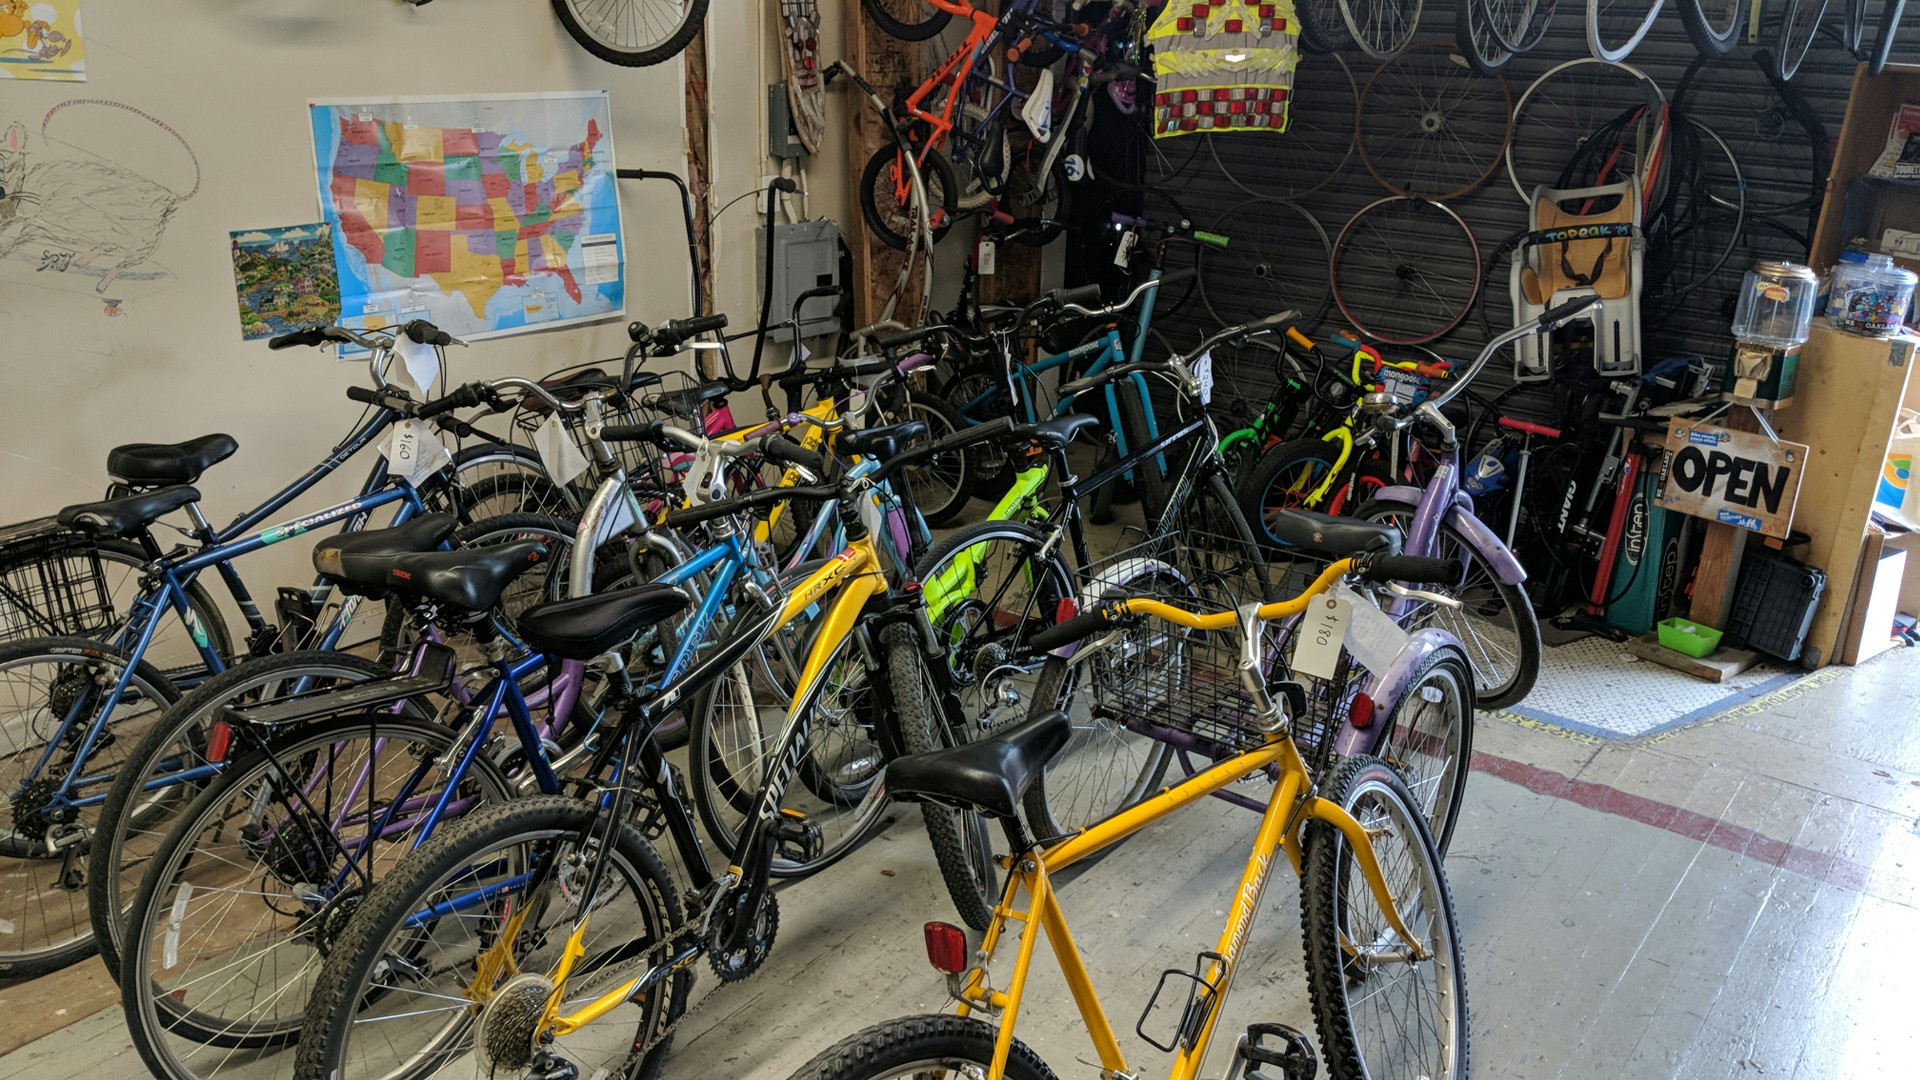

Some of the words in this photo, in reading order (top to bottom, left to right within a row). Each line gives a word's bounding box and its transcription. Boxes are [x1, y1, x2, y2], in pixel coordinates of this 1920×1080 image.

[1896, 165, 1920, 174] TOURET
[1383, 369, 1421, 384] mongoose
[339, 437, 366, 460] DETOUR
[399, 433, 414, 460] $160
[1672, 446, 1790, 515] OPEN
[276, 502, 362, 537] SPECIALIZED
[1557, 479, 1577, 534] GIANT
[1316, 615, 1340, 646] $180
[759, 676, 830, 820] SPECIALIZ
